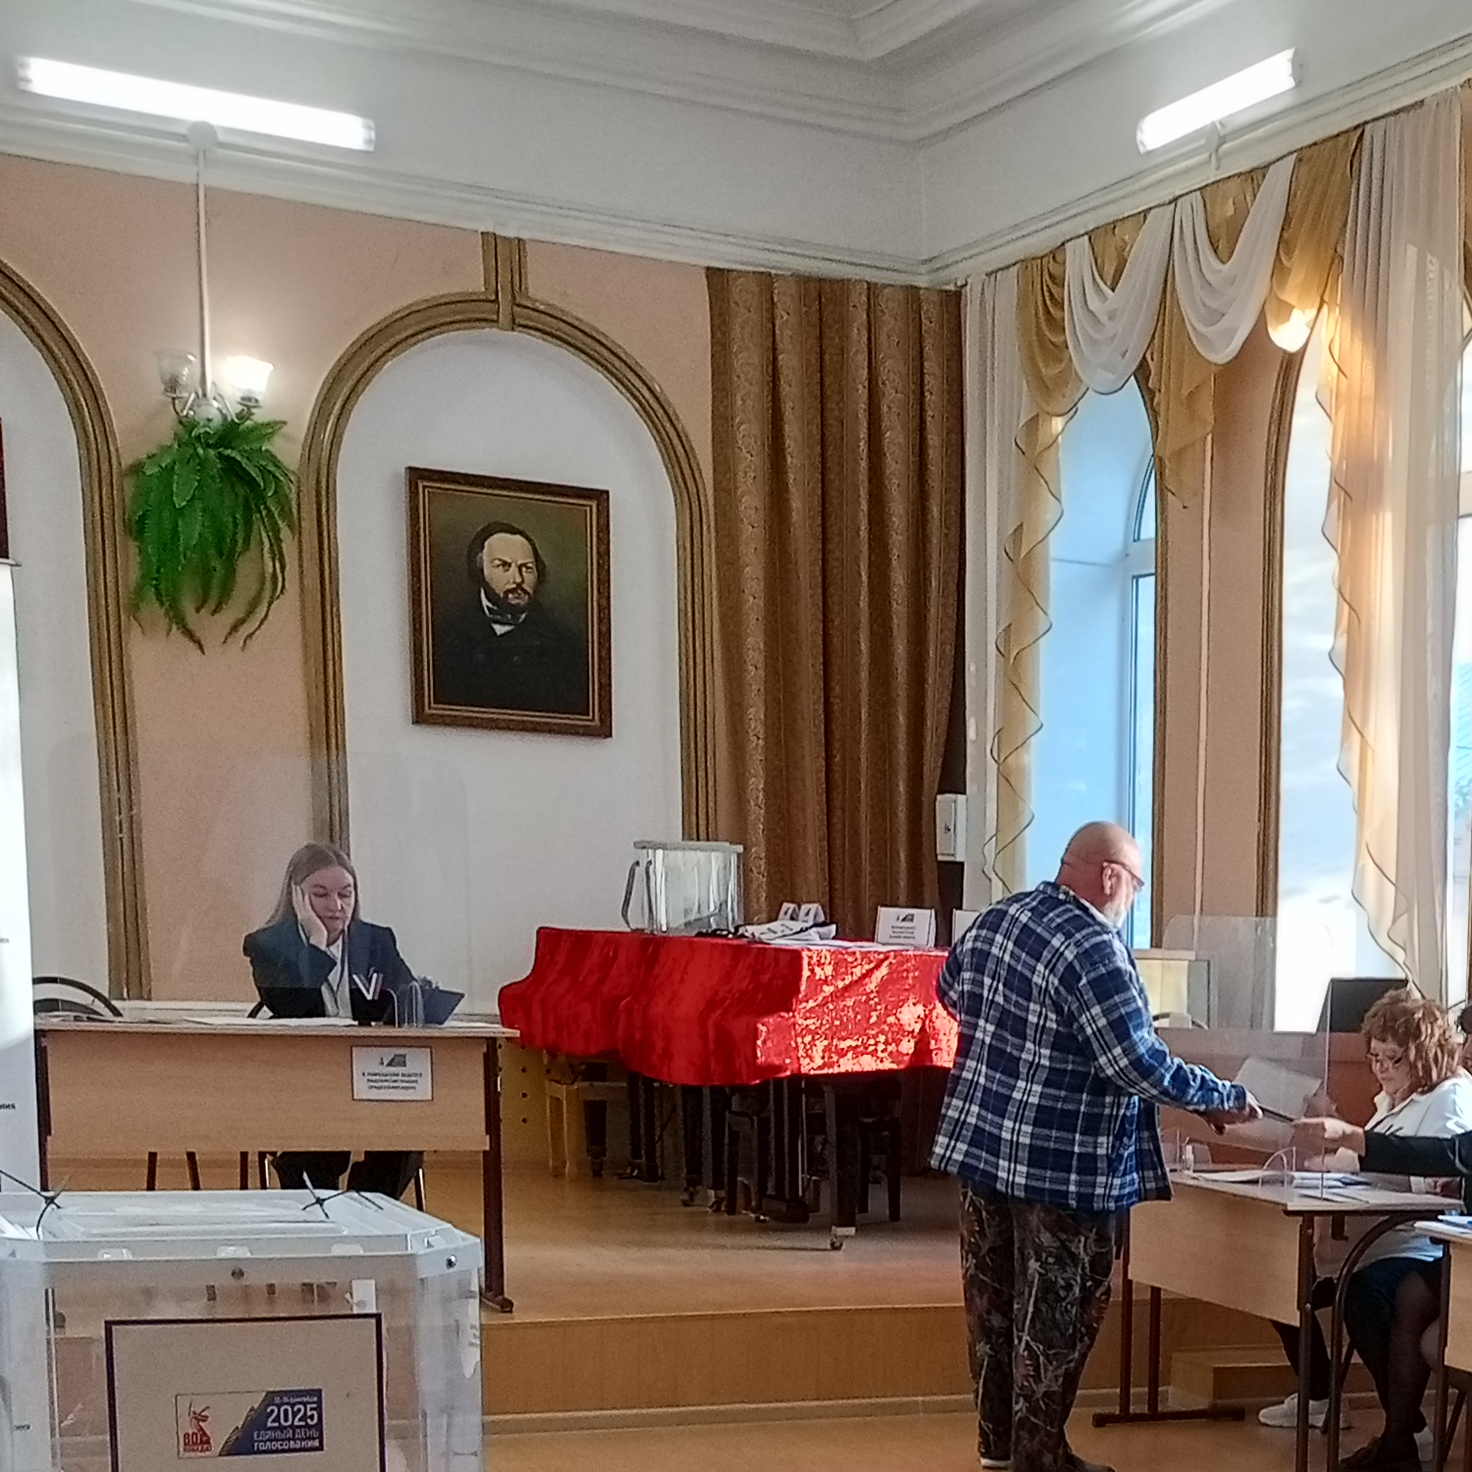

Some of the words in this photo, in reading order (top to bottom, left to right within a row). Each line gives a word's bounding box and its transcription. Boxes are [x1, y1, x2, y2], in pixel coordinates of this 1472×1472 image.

[267, 1404, 318, 1427] 2025
[253, 1428, 293, 1441] ЕДИНЫЙ
[294, 1428, 320, 1440] ДЕНЬ
